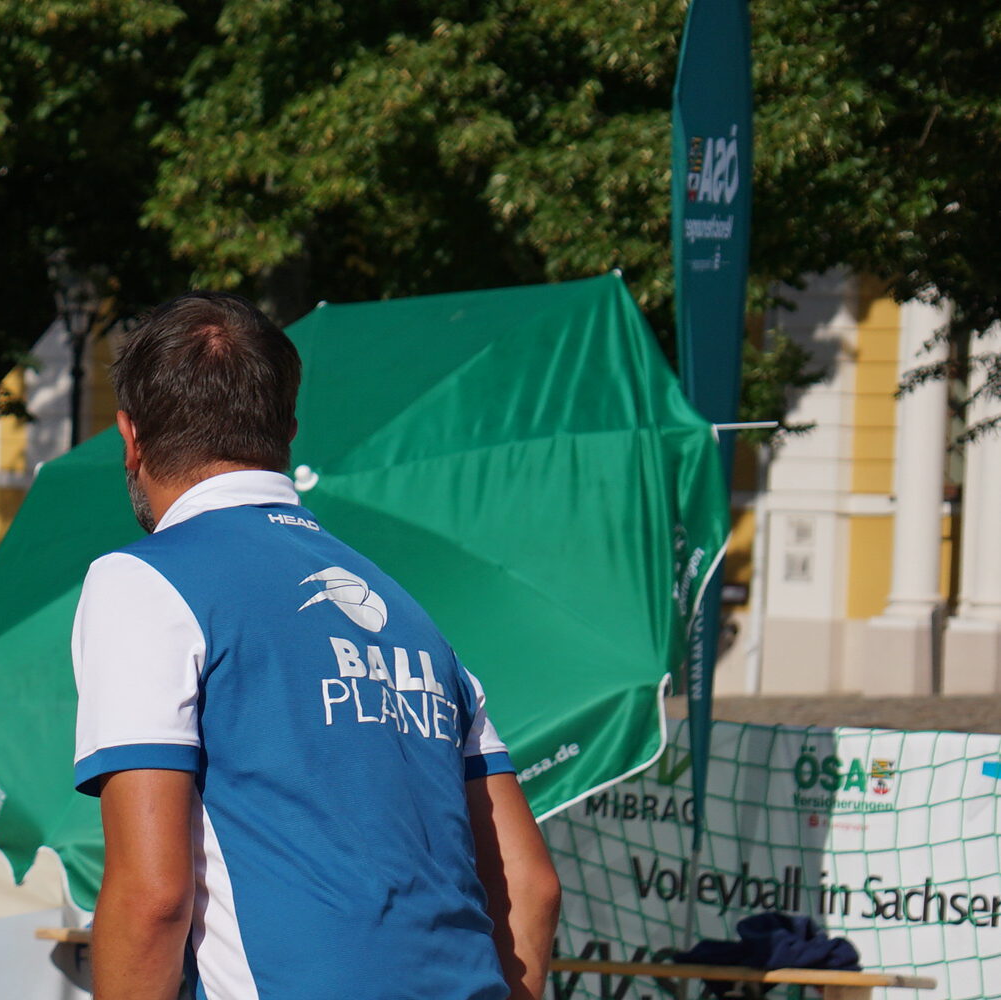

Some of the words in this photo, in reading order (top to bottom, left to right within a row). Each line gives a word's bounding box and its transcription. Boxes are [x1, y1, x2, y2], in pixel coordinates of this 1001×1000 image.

[267, 513, 320, 532] HEAD
[329, 636, 445, 697] BALL
[794, 744, 867, 793] ÖSA
[793, 792, 893, 811] Versicherungen
[632, 856, 800, 917] Volleyball
[820, 870, 850, 916] in
